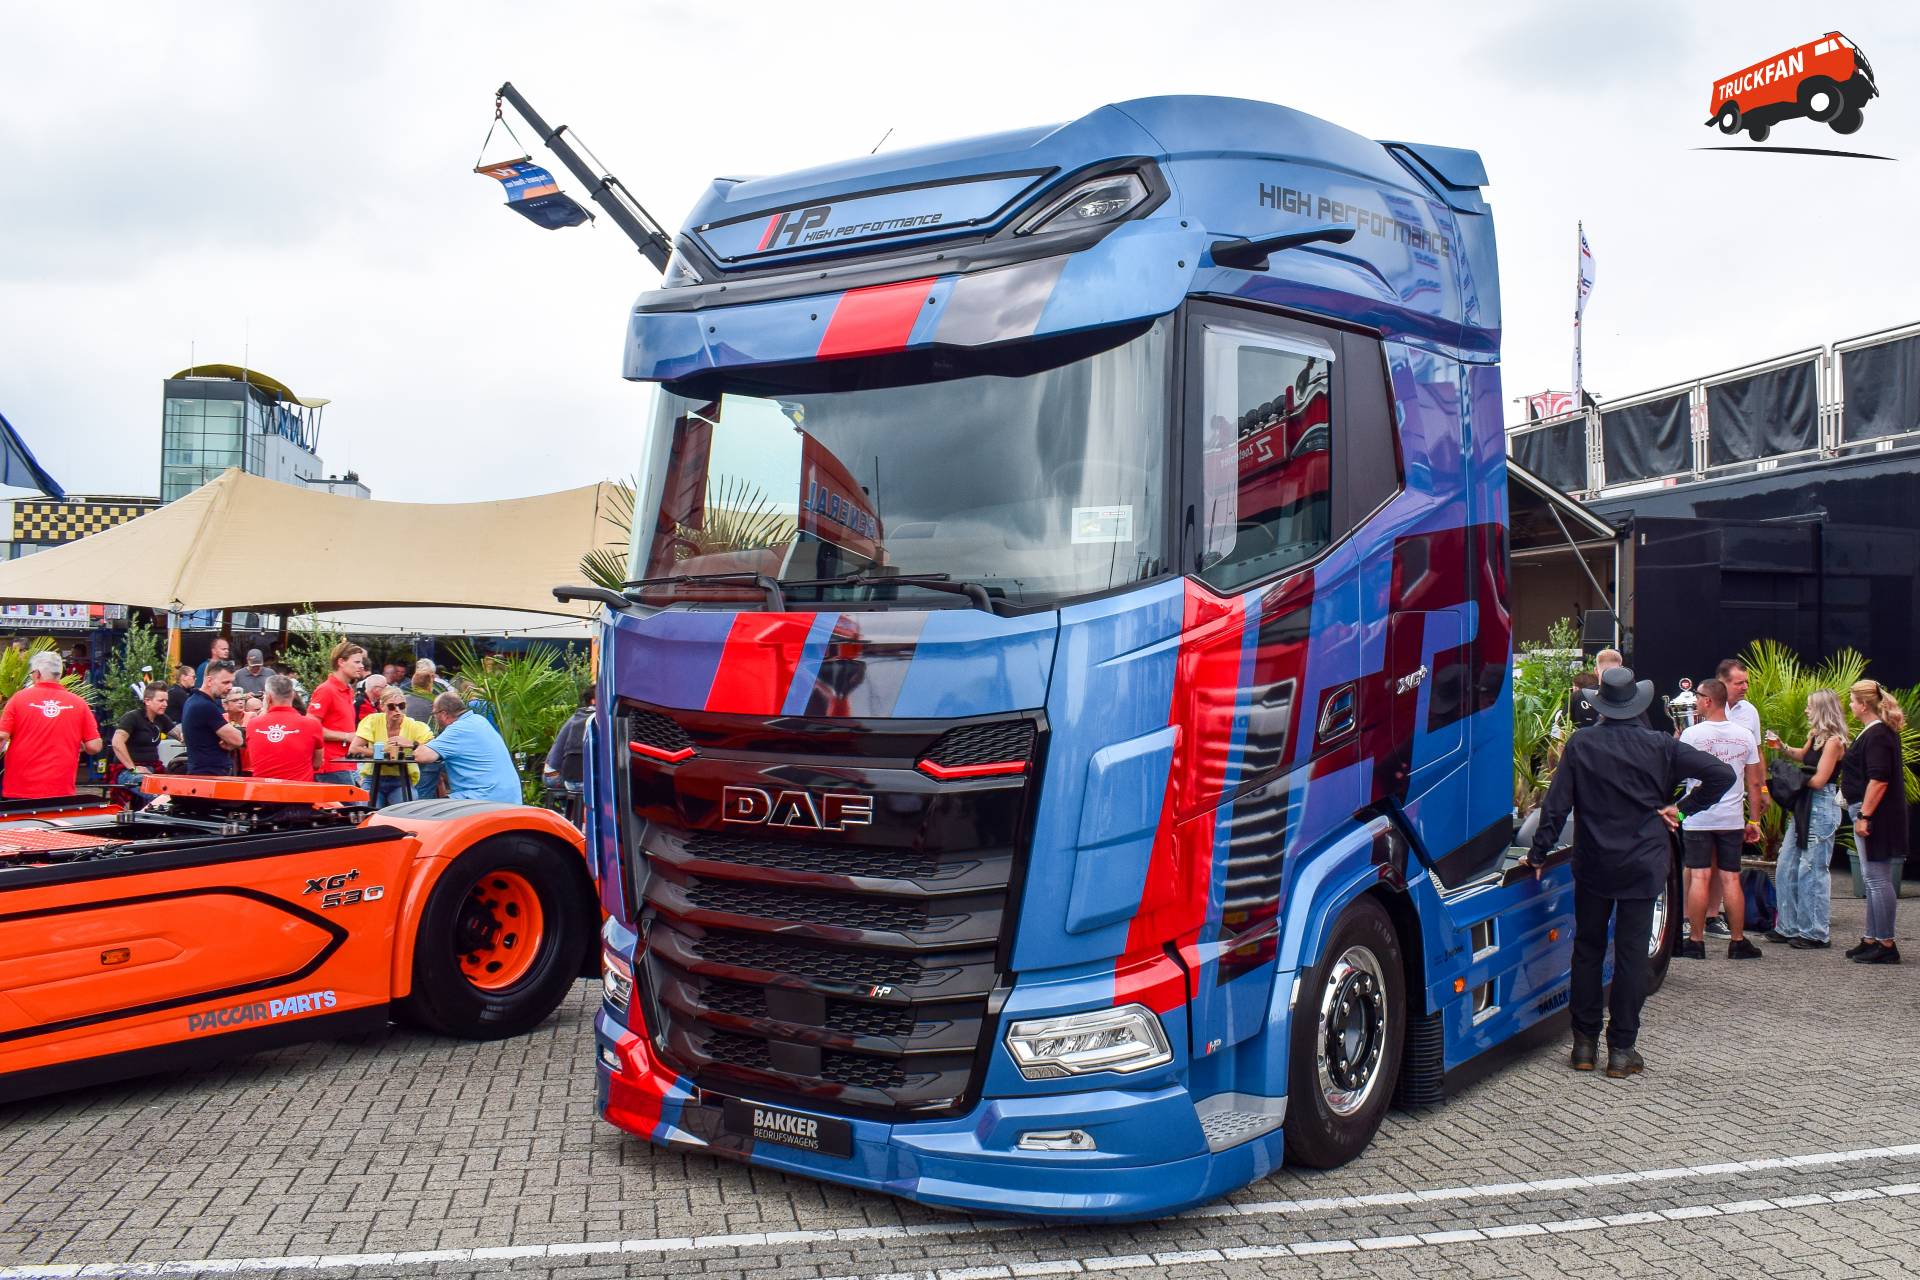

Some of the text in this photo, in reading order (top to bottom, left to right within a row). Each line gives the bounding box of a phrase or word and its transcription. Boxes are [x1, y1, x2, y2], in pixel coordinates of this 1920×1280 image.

[1259, 182, 1312, 218] HIGH
[804, 229, 833, 243] HIGH
[722, 785, 874, 832] DAF
[302, 868, 360, 895] XG+
[320, 884, 385, 910] 530
[187, 989, 338, 1033] PACCAR PARTS
[753, 1108, 818, 1138] BAKKER
[753, 1127, 820, 1150] BEDRIJFSWAGENS
